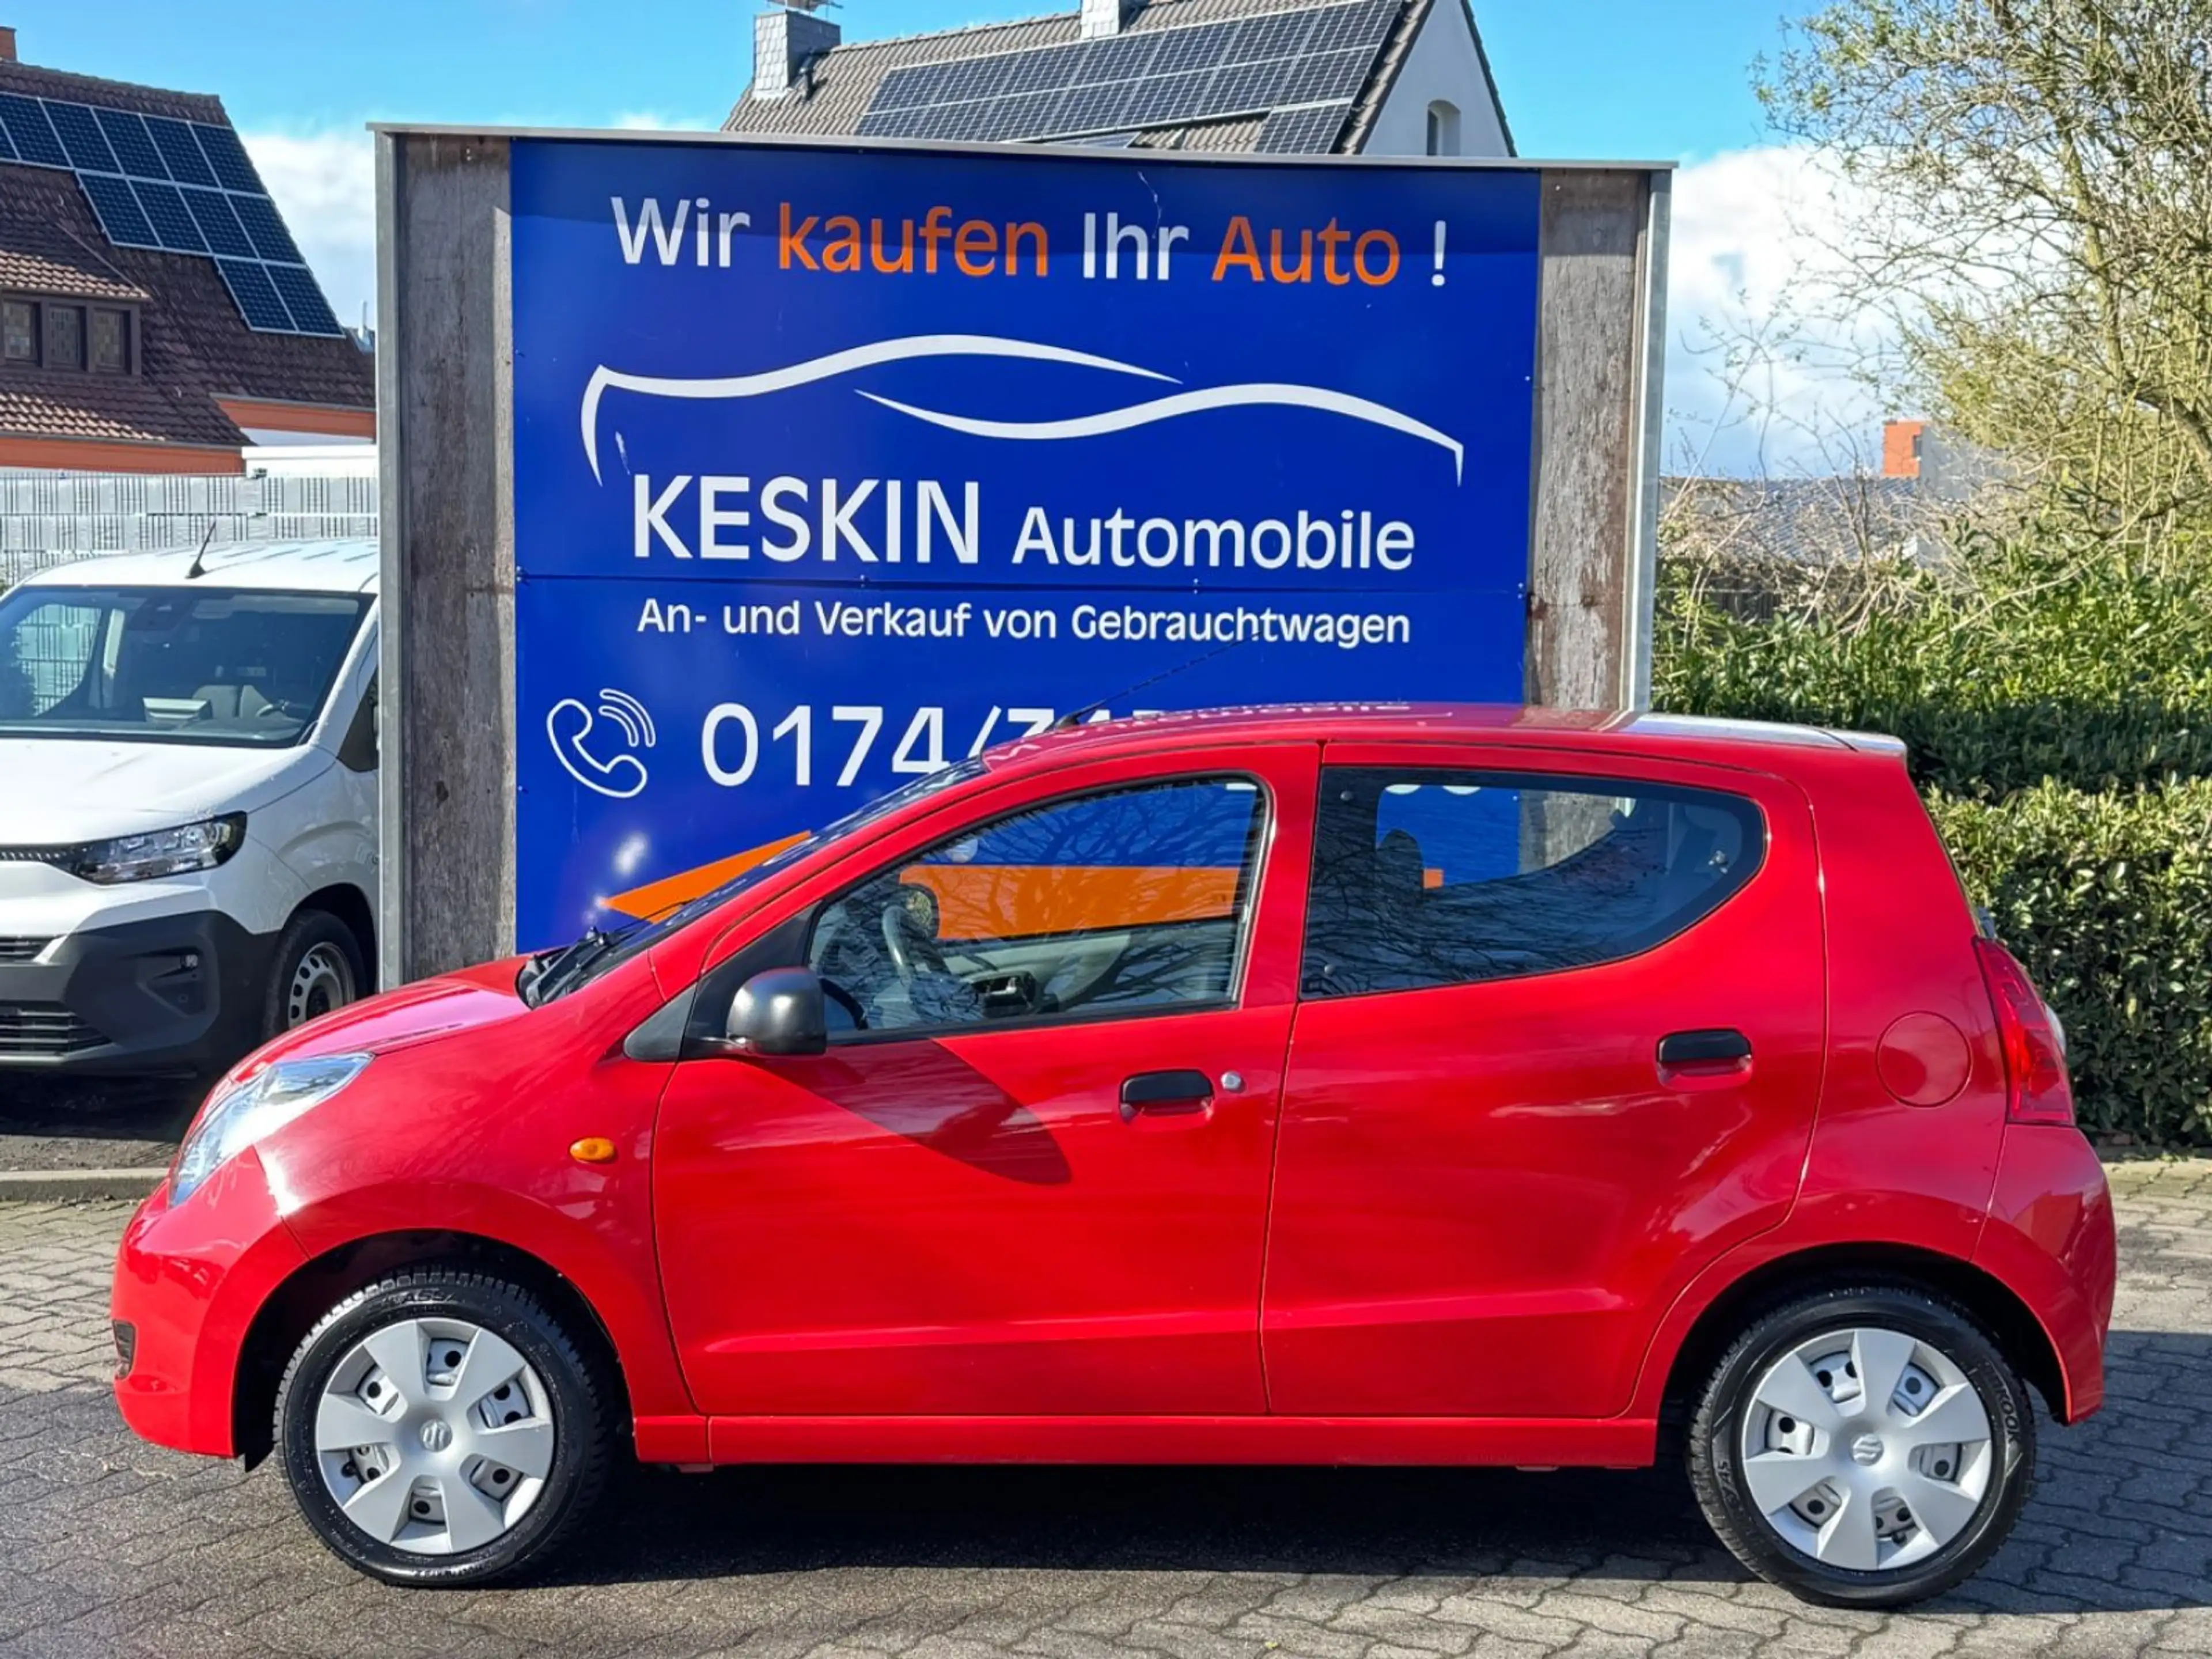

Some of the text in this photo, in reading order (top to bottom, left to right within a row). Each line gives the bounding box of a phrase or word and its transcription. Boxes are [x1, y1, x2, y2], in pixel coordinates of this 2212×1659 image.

[611, 196, 1446, 286] Wir kaufen Ihr Auto !
[634, 474, 1415, 571] KESKIN Automobile
[637, 599, 1410, 649] An- und Verkauf von Gebrauchtwagen
